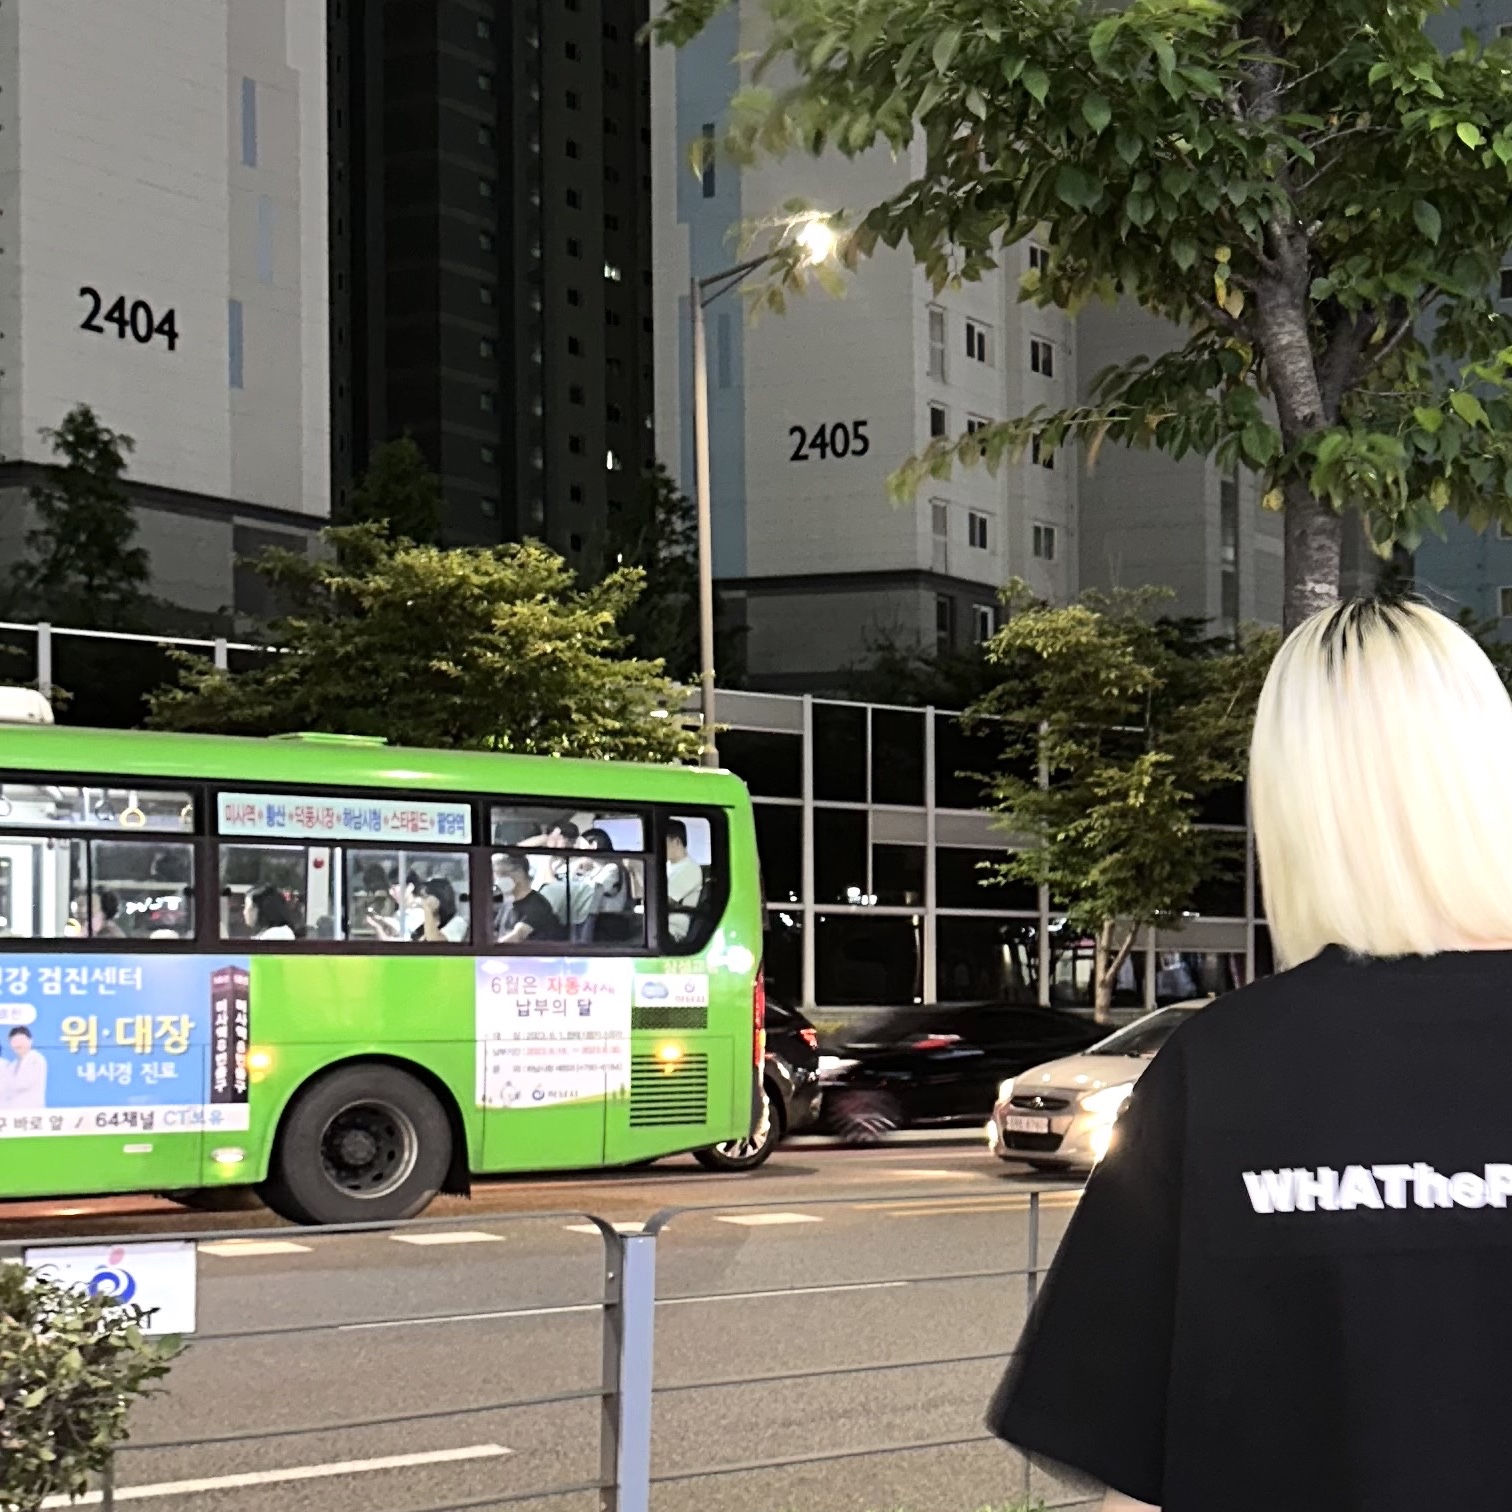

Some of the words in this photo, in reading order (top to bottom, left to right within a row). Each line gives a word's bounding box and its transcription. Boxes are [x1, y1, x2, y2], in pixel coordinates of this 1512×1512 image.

[80, 287, 179, 351] 2404
[789, 420, 869, 461] 2405
[38, 966, 143, 996] 검진센터
[491, 975, 538, 995] 6월은
[516, 998, 567, 1017] 납부의
[577, 998, 593, 1017] 달
[77, 1061, 134, 1085] 내시경
[140, 1061, 180, 1085] 진료
[14, 1116, 44, 1131] 바로
[95, 1111, 156, 1131] 64채널
